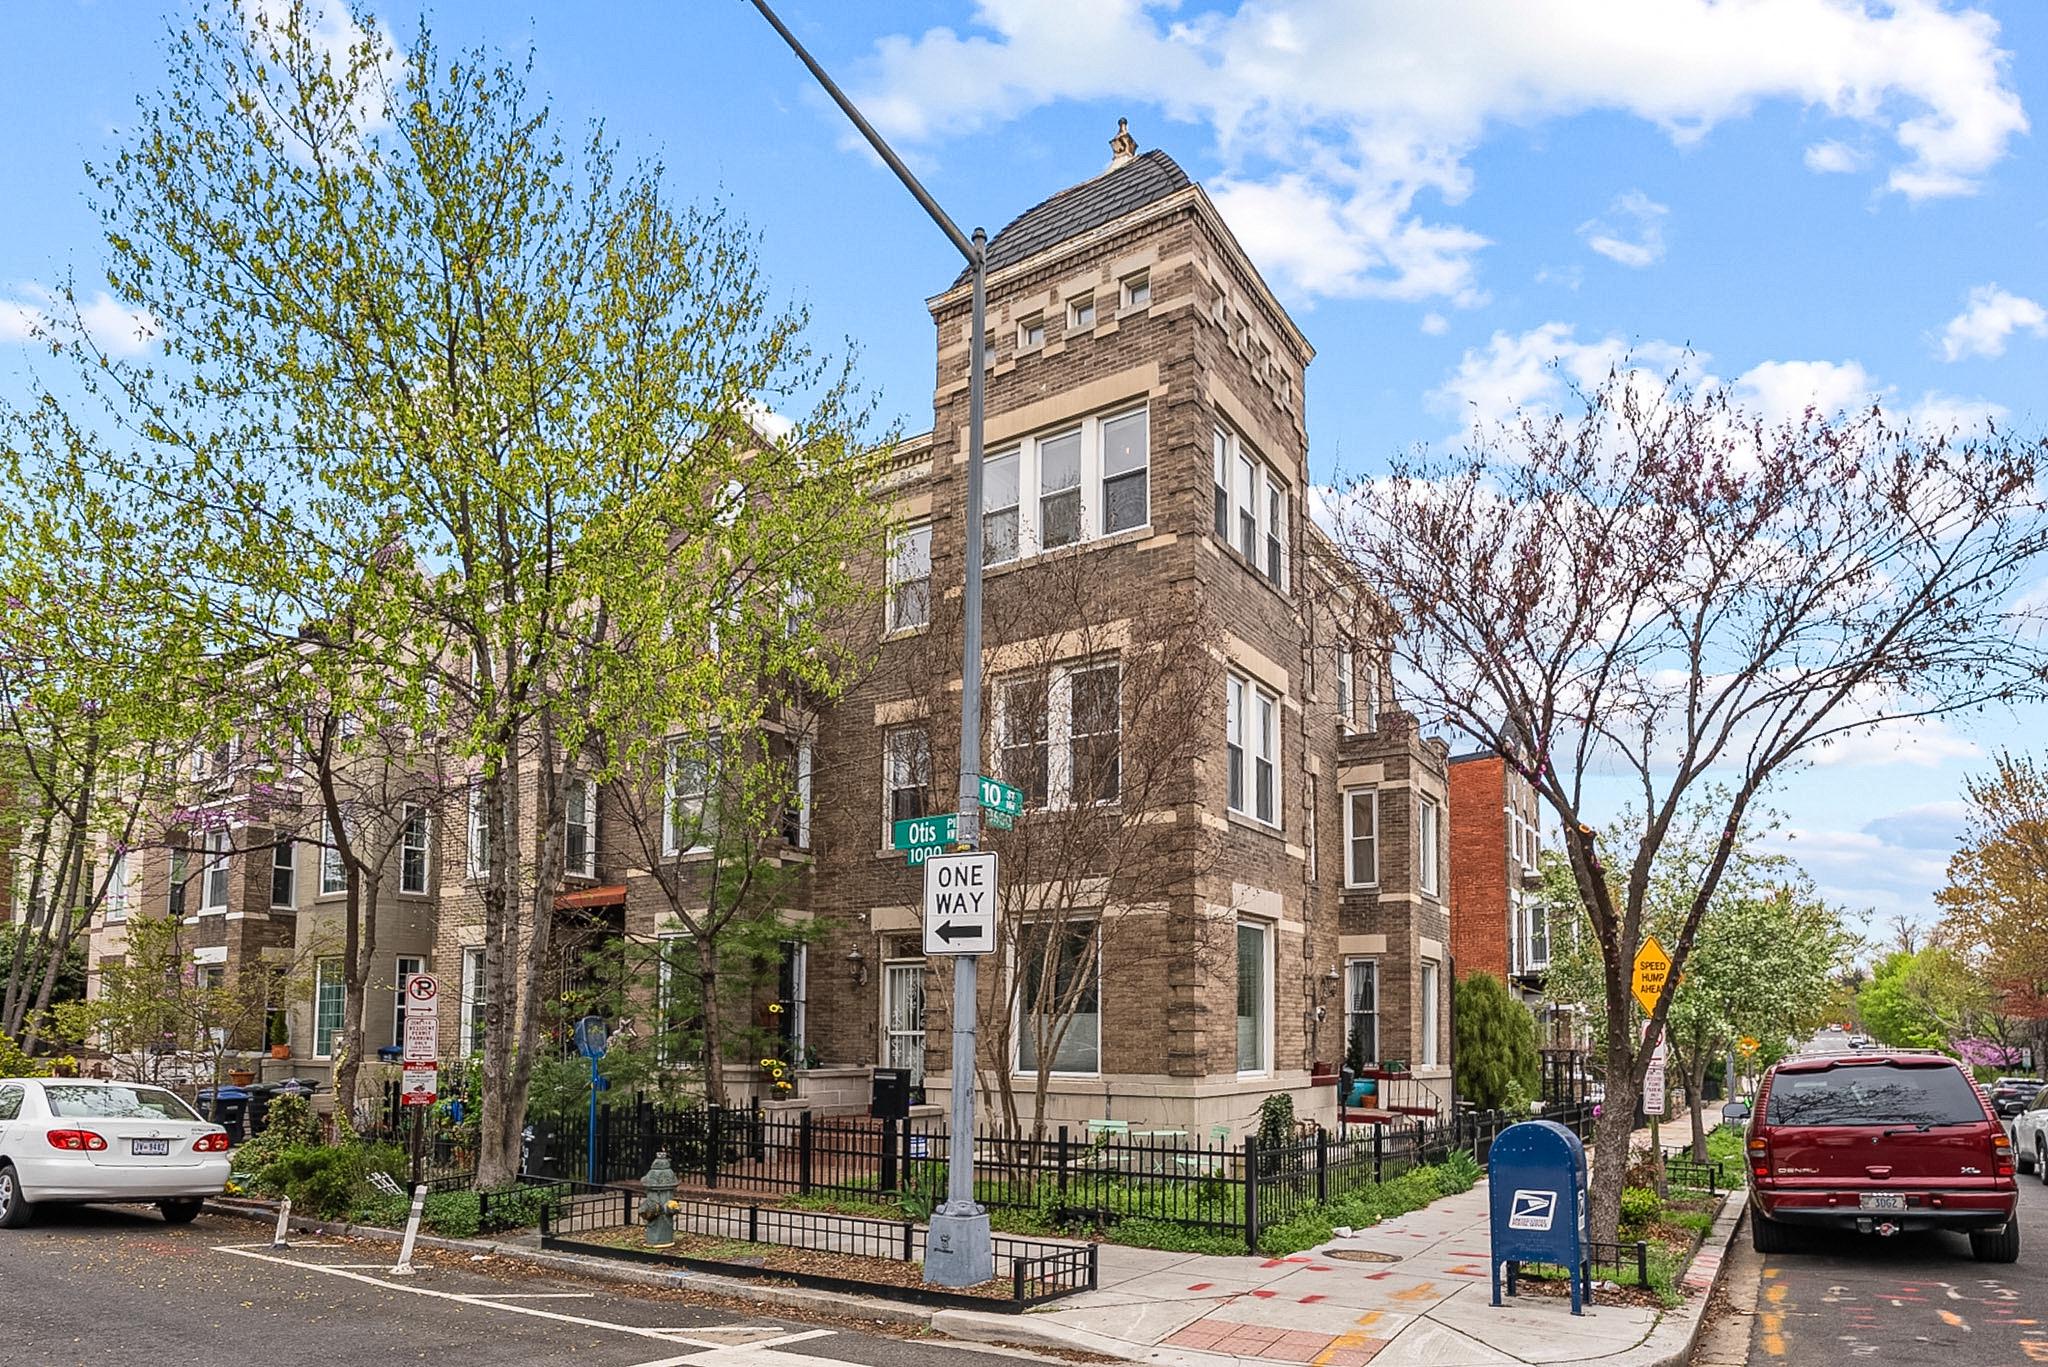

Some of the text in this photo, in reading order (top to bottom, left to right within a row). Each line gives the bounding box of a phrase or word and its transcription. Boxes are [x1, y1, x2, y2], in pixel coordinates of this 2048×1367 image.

[982, 782, 1001, 806] 10
[909, 821, 937, 844] Otis
[938, 864, 984, 888] ONE
[936, 891, 985, 915] WAY
[1640, 960, 1666, 971] SPEED
[1641, 973, 1665, 983] HUMP
[1641, 984, 1664, 994] AHEA
